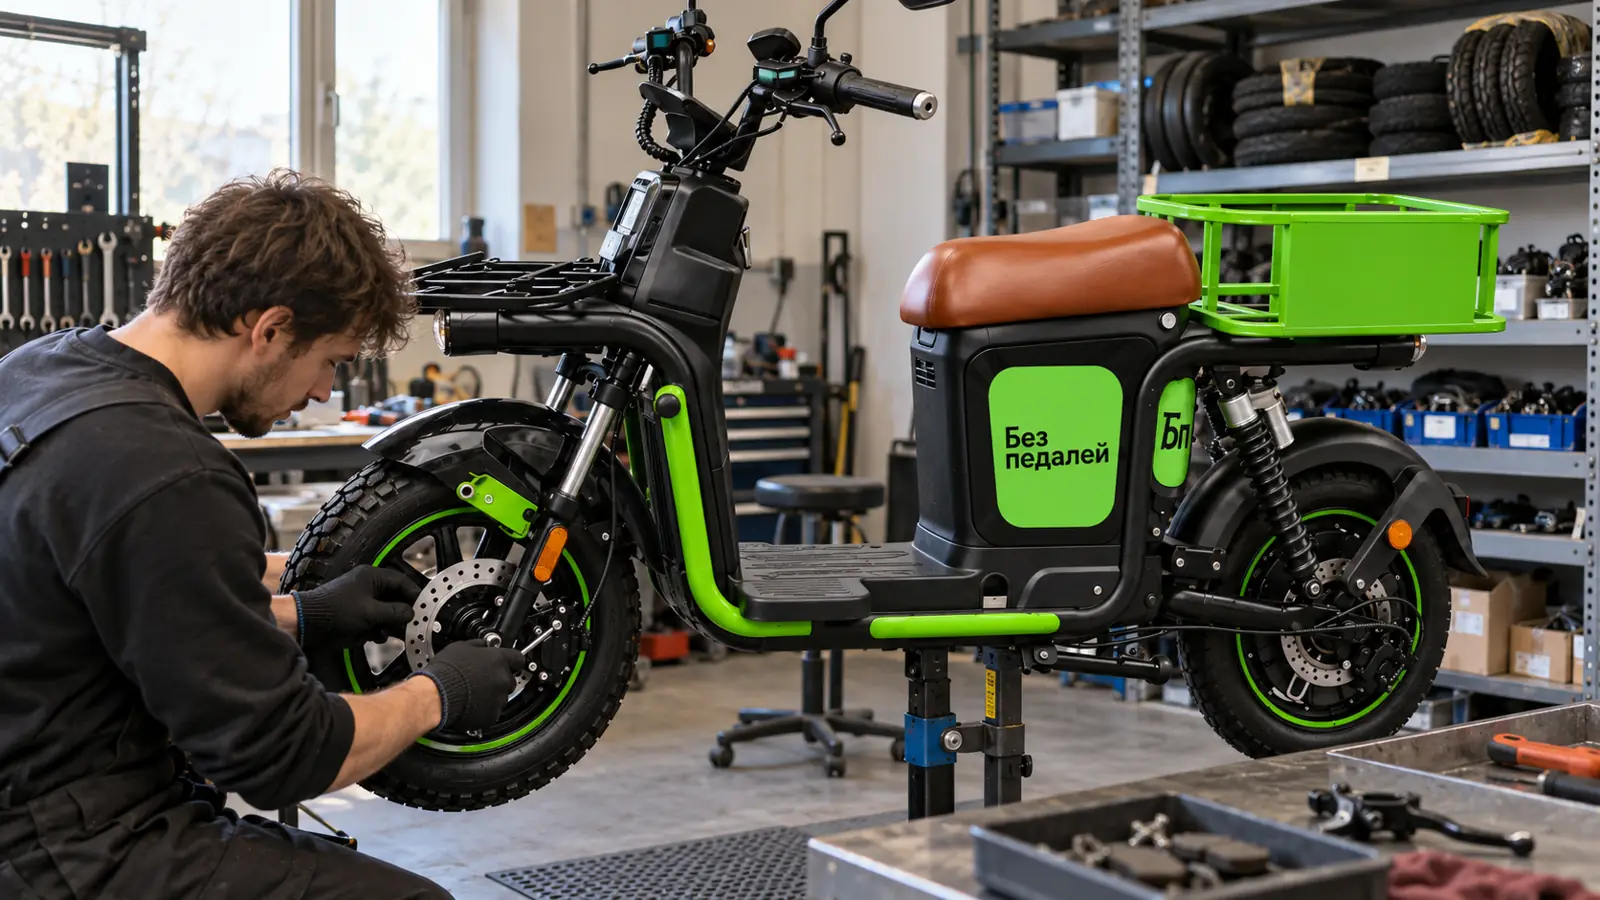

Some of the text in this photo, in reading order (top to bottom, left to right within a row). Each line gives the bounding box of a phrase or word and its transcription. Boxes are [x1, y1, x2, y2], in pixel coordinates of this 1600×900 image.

[1005, 426, 1048, 449] Без
[1161, 411, 1190, 450] Бп
[1005, 442, 1109, 471] педалей
